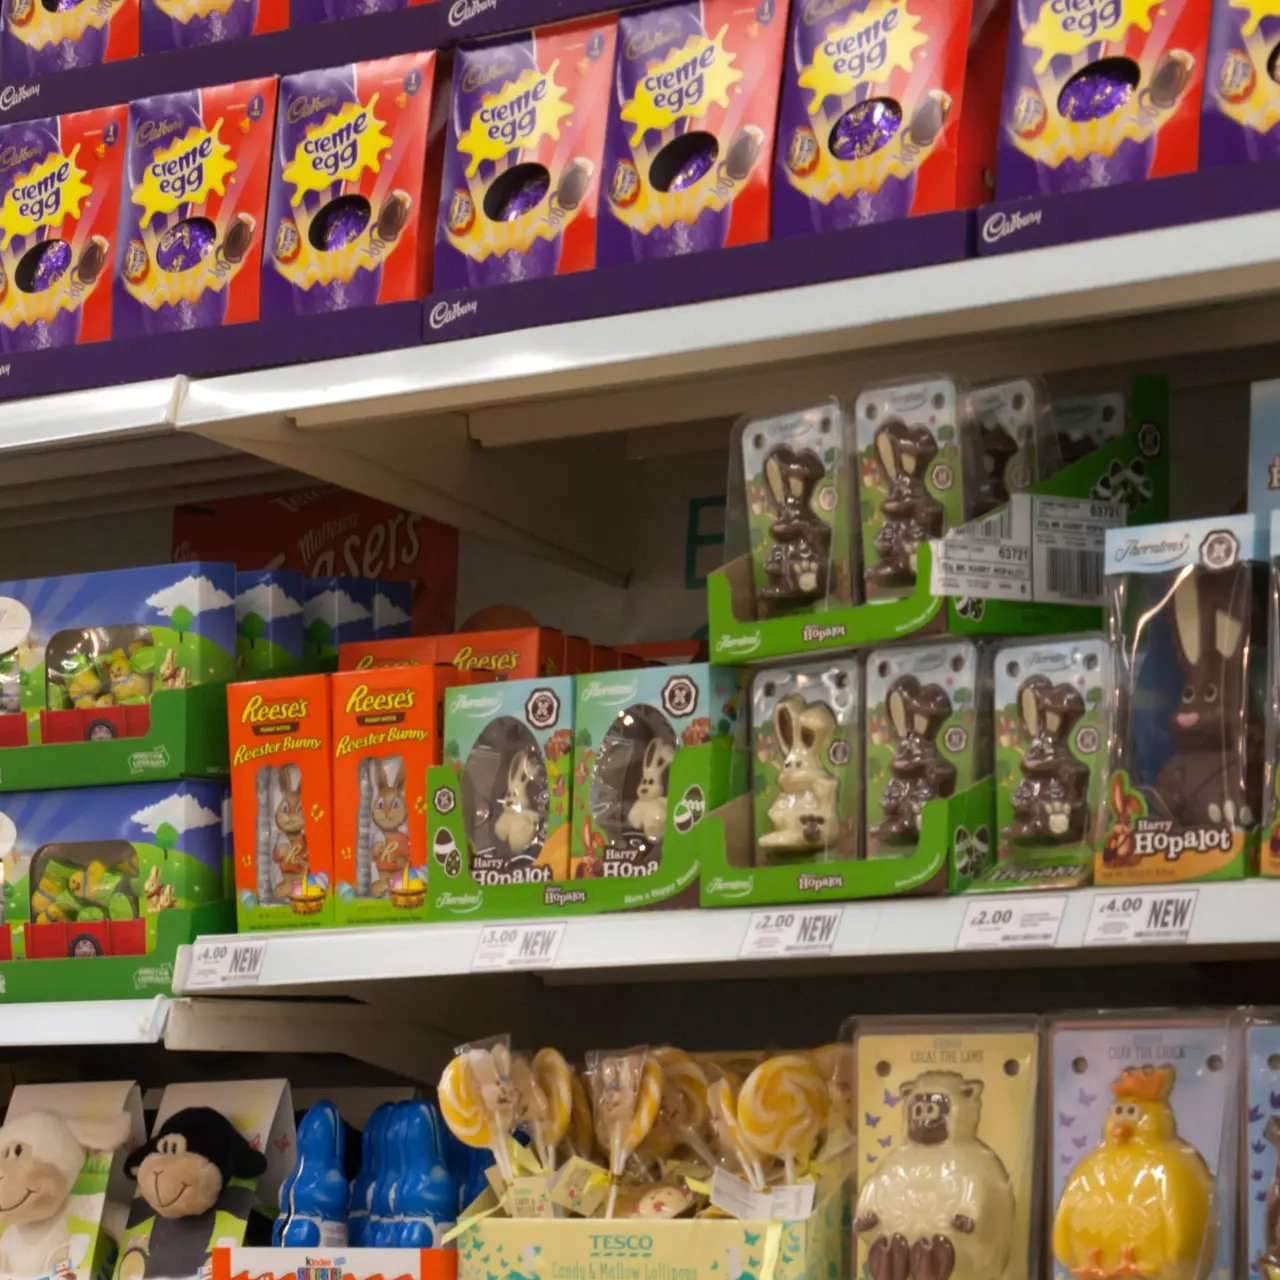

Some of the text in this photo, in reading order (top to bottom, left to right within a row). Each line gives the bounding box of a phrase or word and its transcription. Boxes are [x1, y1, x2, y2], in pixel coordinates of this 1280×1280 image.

[12, 161, 71, 205] creme
[19, 189, 61, 222] egg
[1115, 535, 1189, 561] Thorntons
[242, 695, 307, 723] Reese's
[234, 735, 321, 766] Reester Bunny
[1135, 828, 1231, 855] Hopalot
[1147, 898, 1191, 927] NEW
[230, 952, 262, 973] NEW
[589, 1235, 653, 1252] TESCO
[551, 1263, 583, 1280] Candy
[599, 1263, 639, 1280] Mallow
